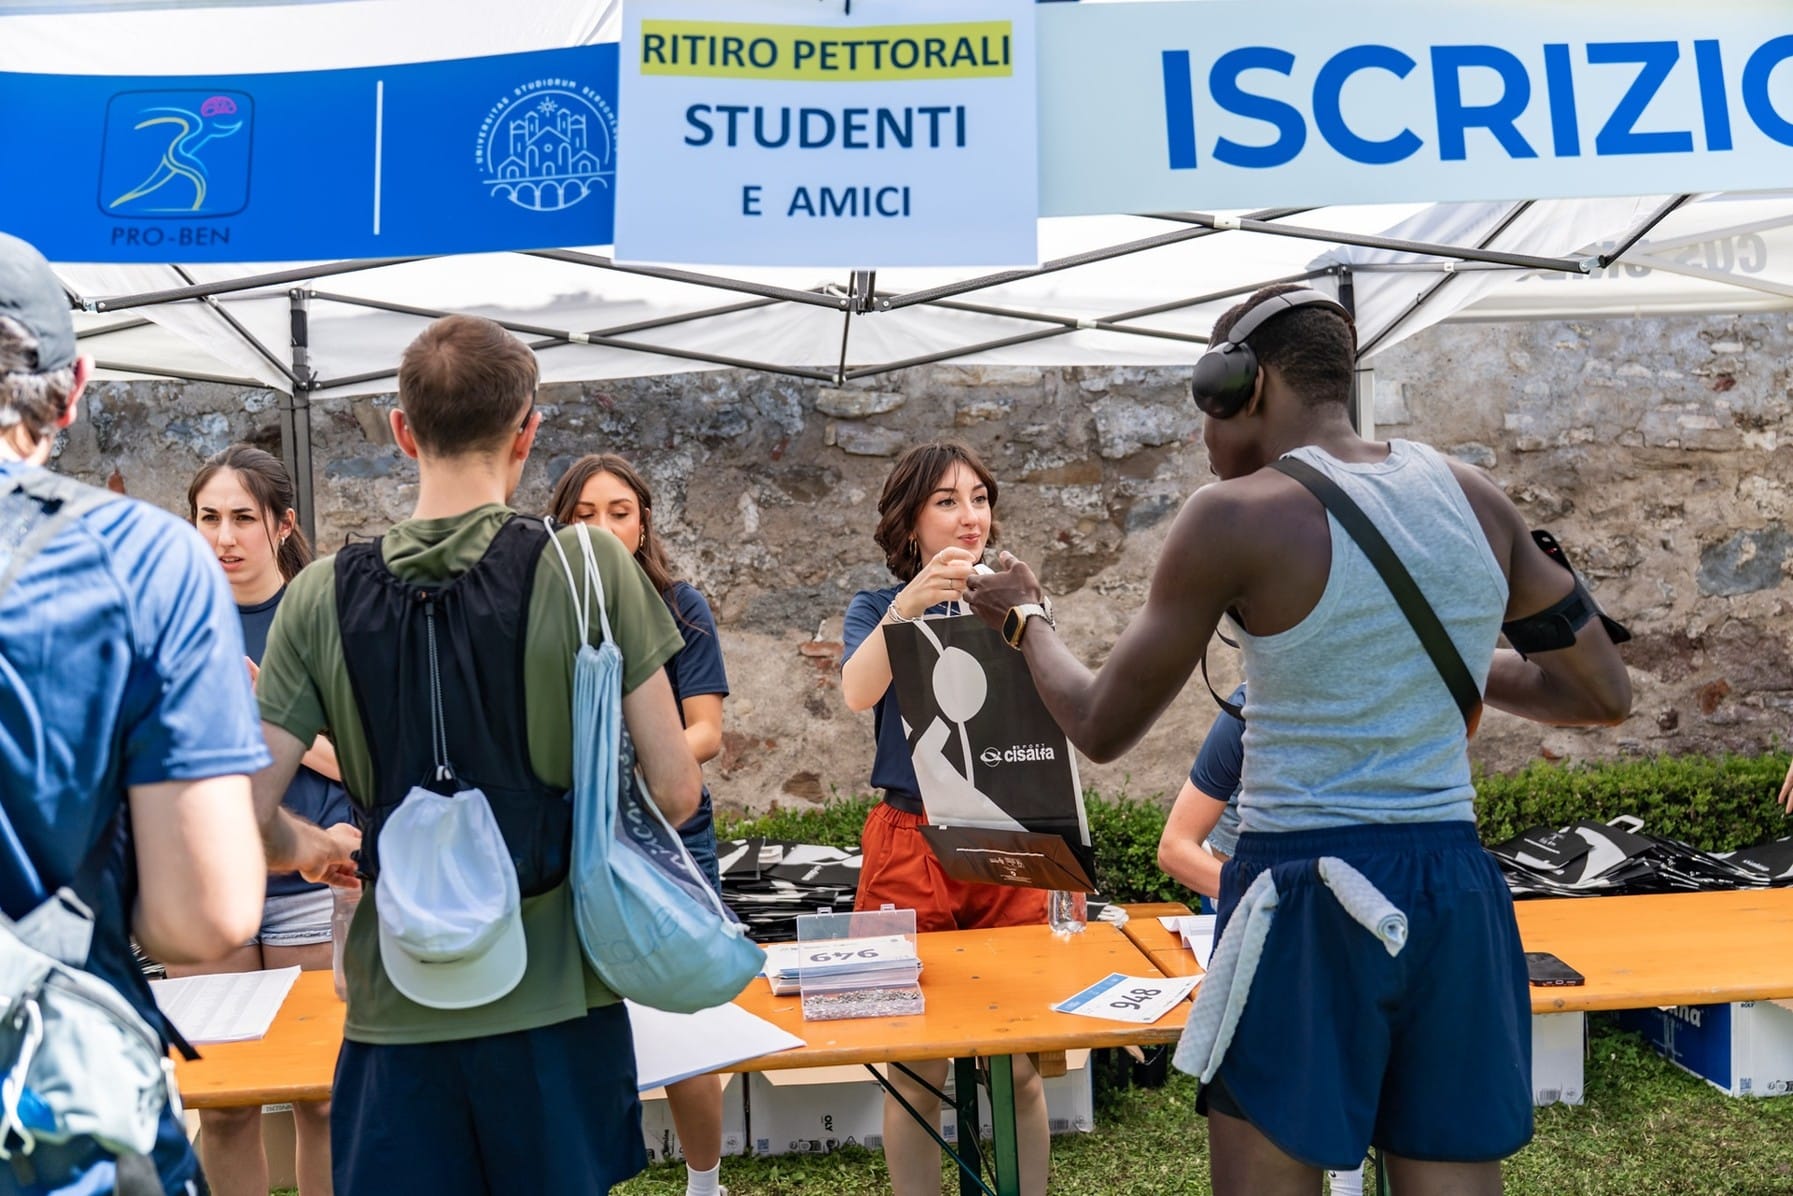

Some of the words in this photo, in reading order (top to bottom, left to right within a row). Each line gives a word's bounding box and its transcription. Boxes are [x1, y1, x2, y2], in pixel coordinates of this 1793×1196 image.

[643, 33, 778, 69] RITIRO
[794, 35, 1011, 71] PETTORALI
[513, 78, 577, 96] STUDIORUM
[684, 103, 966, 150] STUDENTI
[742, 185, 763, 216] E
[787, 186, 911, 218] AMICI
[111, 226, 230, 247] PRO-BEN
[1004, 745, 1055, 762] cisalfa
[809, 948, 880, 963] 949
[1109, 988, 1162, 1011] 948
